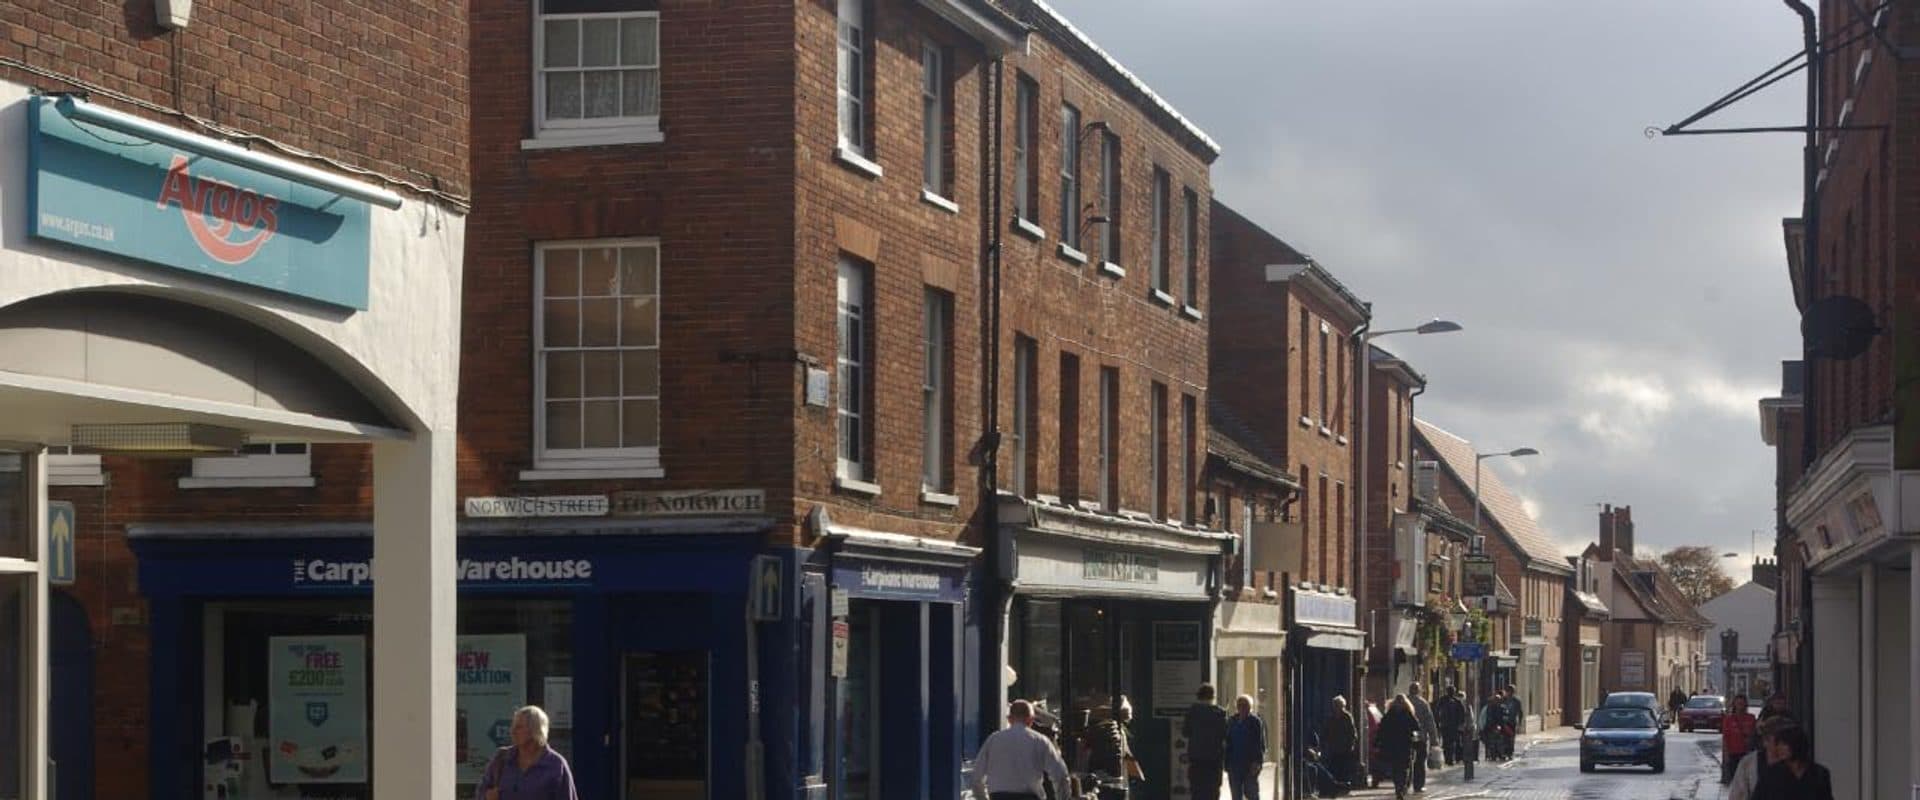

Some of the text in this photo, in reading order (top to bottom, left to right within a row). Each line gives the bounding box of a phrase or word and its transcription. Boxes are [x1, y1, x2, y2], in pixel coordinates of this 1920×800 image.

[157, 154, 278, 263] Argos
[41, 214, 114, 241] www.argos.co.uk
[470, 498, 604, 513] NORWICH STREET
[656, 495, 761, 511] NORWICH
[306, 652, 343, 668] FREE
[288, 670, 325, 686] £200
[457, 671, 512, 684] RSATION
